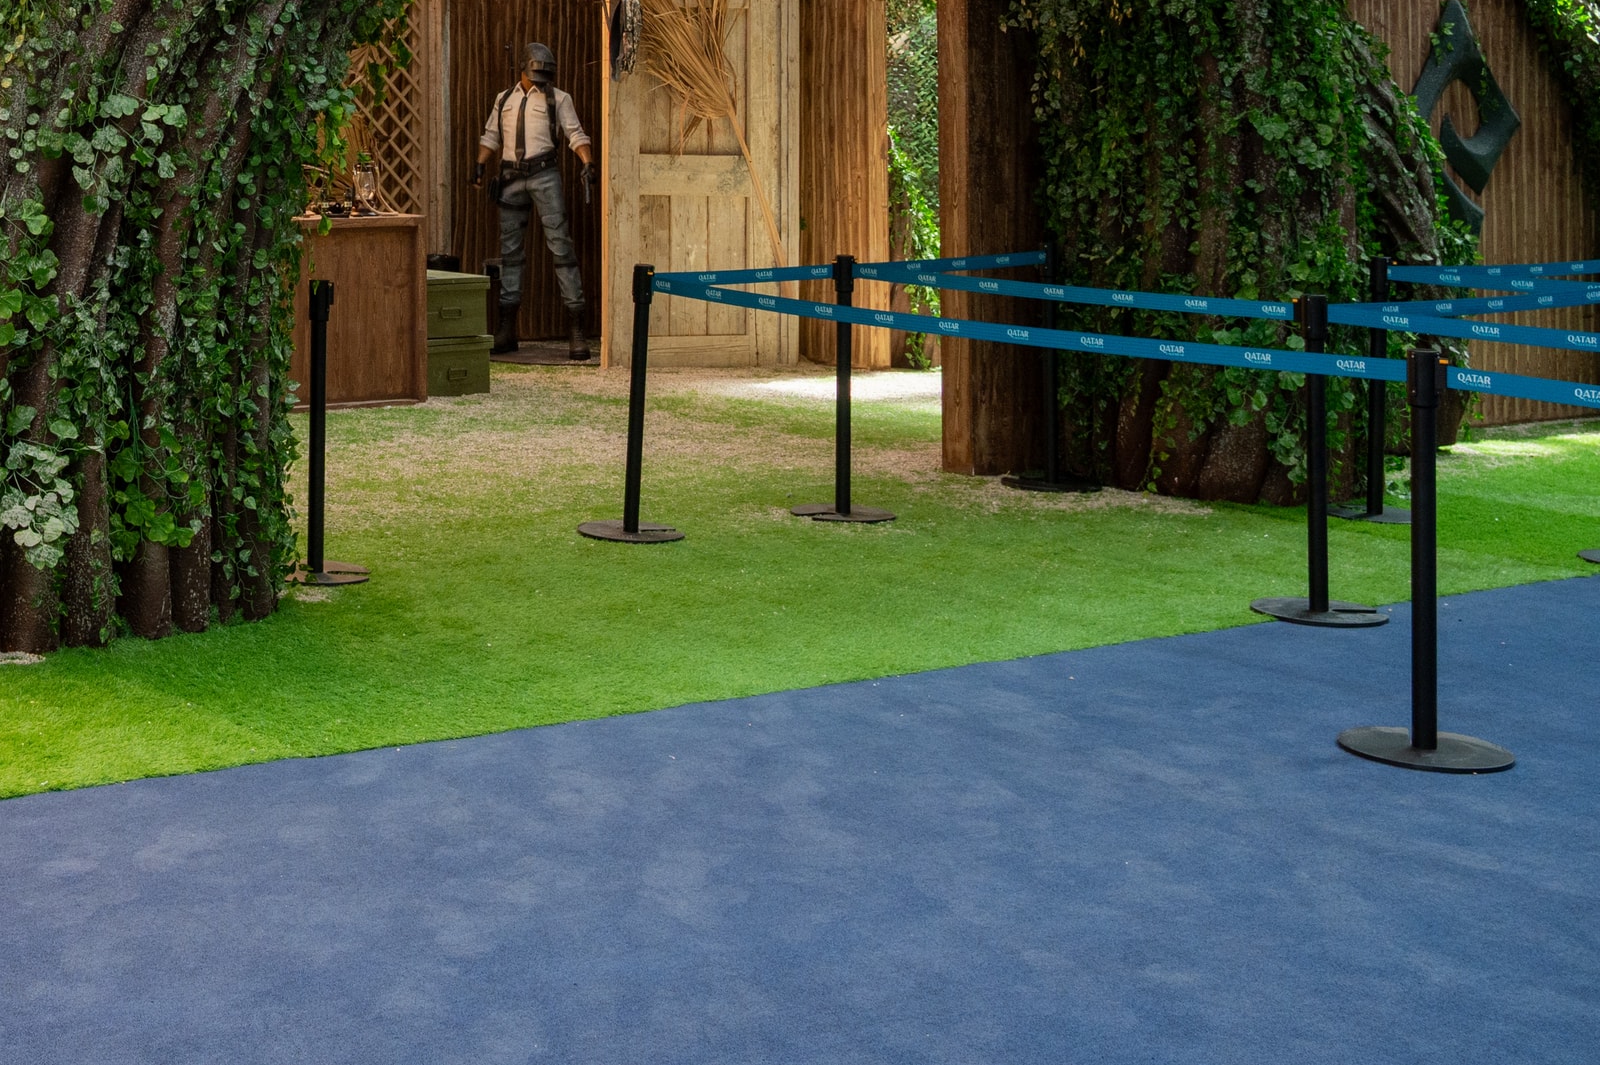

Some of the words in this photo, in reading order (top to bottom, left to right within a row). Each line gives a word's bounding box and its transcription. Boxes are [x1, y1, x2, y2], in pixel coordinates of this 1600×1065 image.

[979, 281, 998, 290] QATAR
[1044, 288, 1064, 297] QATAR
[1112, 293, 1133, 302] QATAR
[1185, 299, 1207, 308] QATAR
[815, 305, 832, 314] QATAR
[1262, 305, 1286, 314] QATAR
[875, 313, 894, 322] QATAR
[1383, 316, 1408, 325] QATAR
[939, 321, 959, 330] QATAR
[1472, 325, 1500, 335] QATAR
[1007, 329, 1029, 338] QATAR
[1081, 336, 1104, 346] QATAR
[1567, 335, 1597, 346] QATAR
[1160, 344, 1184, 354] QATAR
[1244, 351, 1271, 361] QATAR
[1336, 360, 1366, 370] QATAR
[1457, 372, 1491, 384] QATAR
[1574, 388, 1600, 400] QATA
